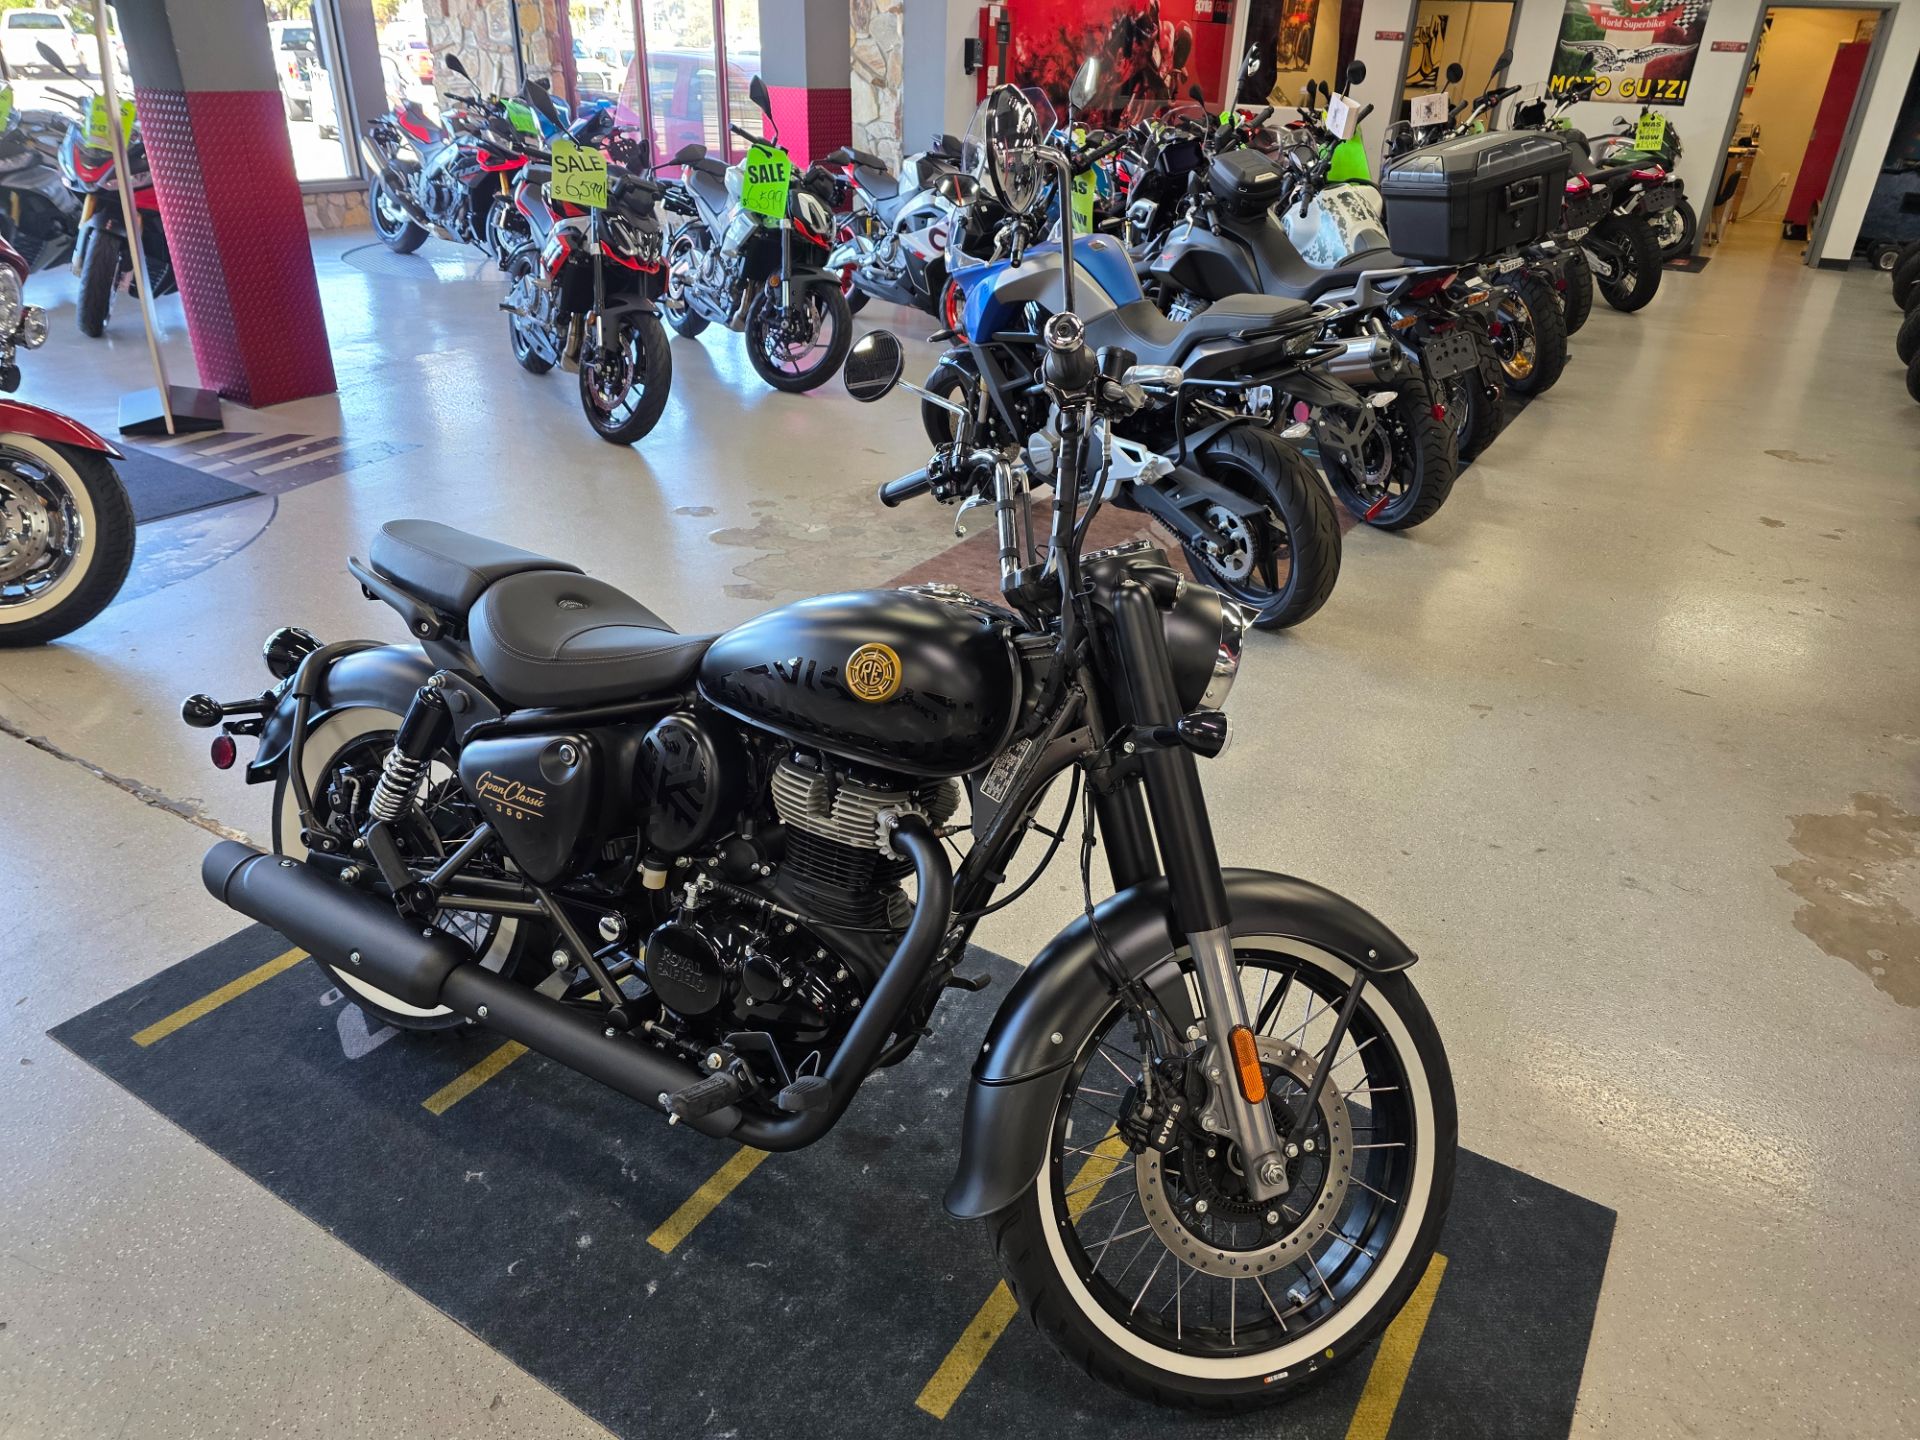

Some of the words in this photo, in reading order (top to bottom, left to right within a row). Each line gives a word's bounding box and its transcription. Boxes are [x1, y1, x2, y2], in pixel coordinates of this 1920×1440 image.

[1600, 16, 1622, 27] World
[1623, 18, 1666, 30] Superbikes
[554, 155, 604, 173] SALE
[747, 162, 786, 184] SALE
[1071, 181, 1088, 195] AS
[475, 771, 505, 798] Goan
[503, 781, 545, 807] Classic
[496, 804, 523, 819] 350
[661, 948, 703, 977] ROYAL
[657, 962, 707, 993] ENFIELD
